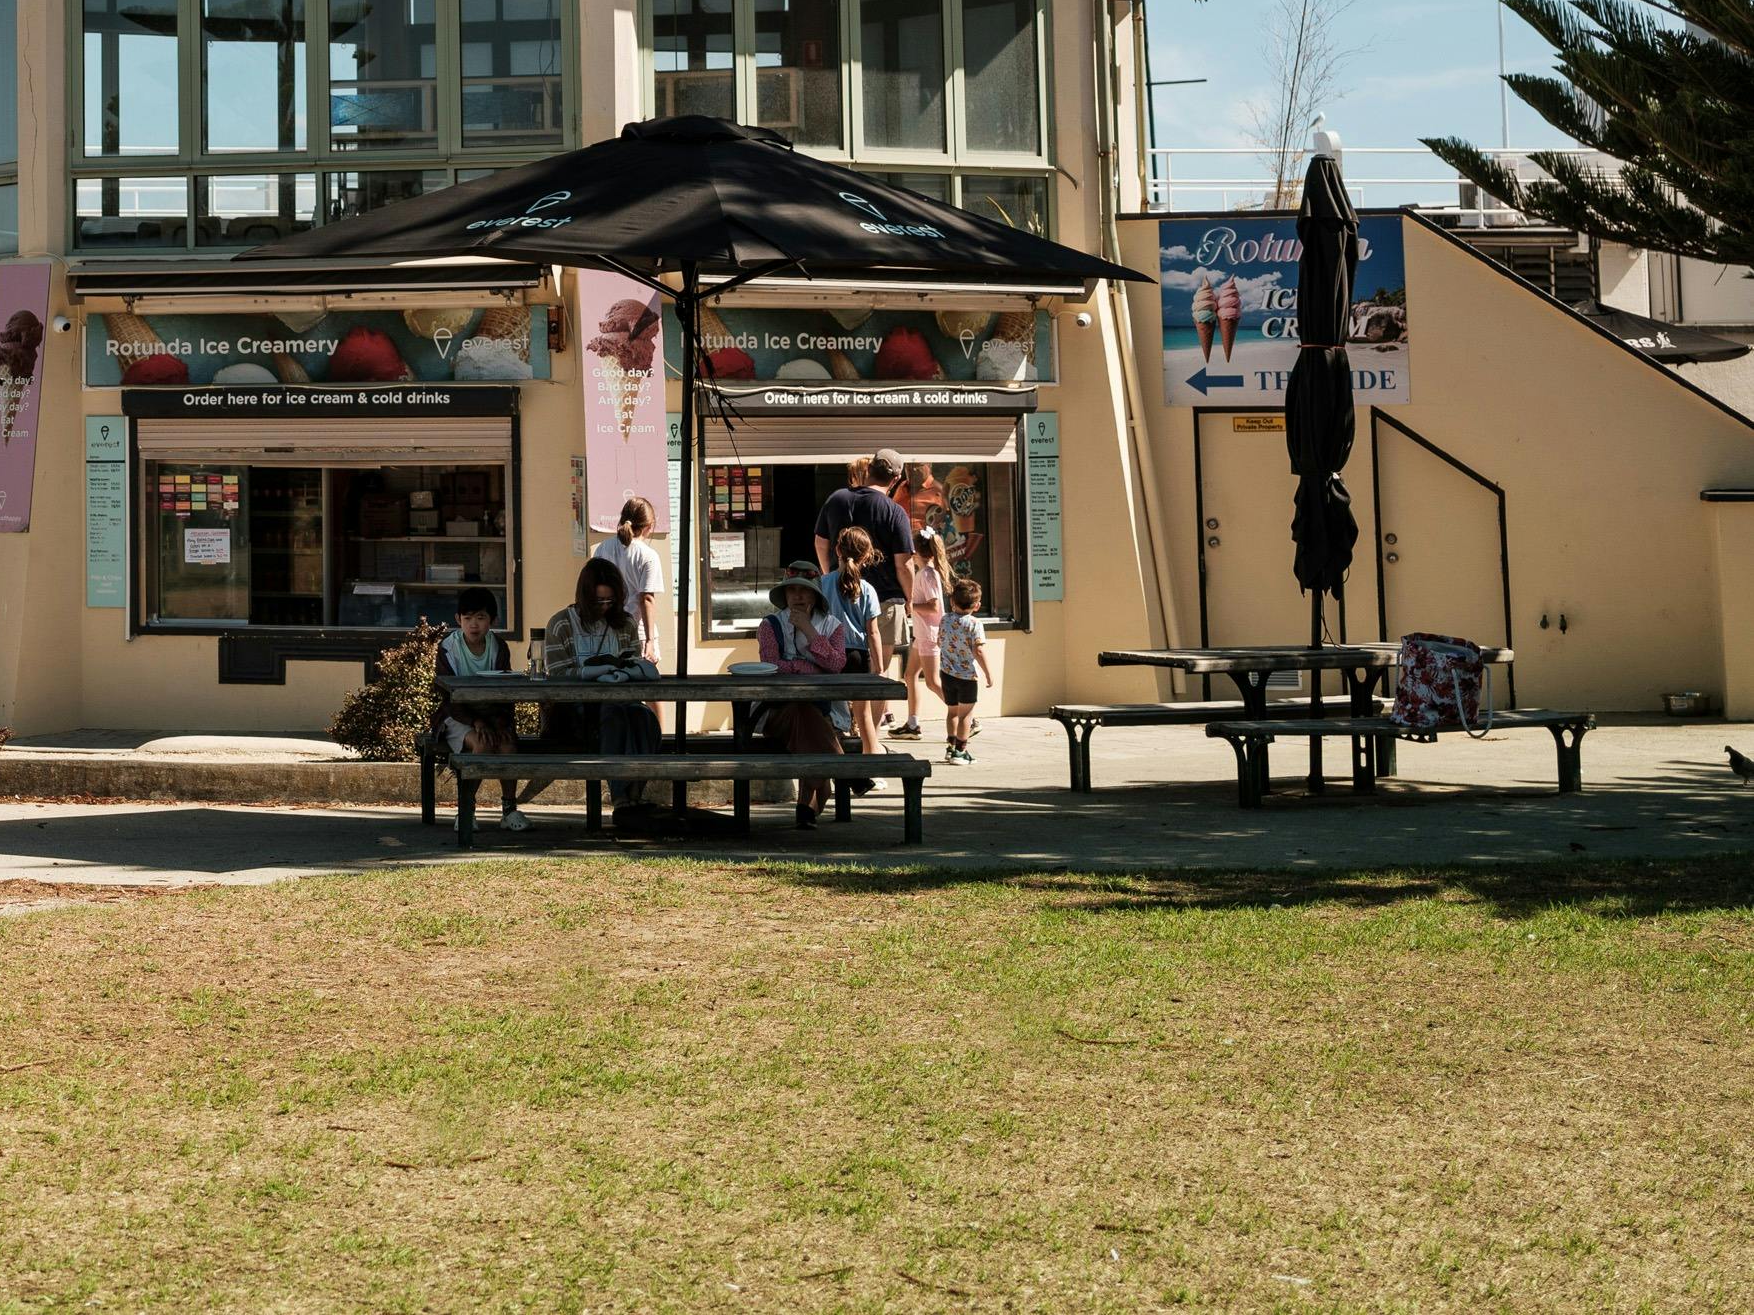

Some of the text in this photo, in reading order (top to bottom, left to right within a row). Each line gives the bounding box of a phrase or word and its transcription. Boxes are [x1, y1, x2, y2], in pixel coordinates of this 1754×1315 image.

[466, 216, 572, 230] everest
[859, 221, 946, 239] everest
[1196, 226, 1373, 266] Rotua
[1260, 287, 1298, 310] IC
[1261, 315, 1368, 339] CRM
[106, 336, 339, 356] Rotunda Ice Creamery
[461, 333, 530, 350] everest
[680, 332, 883, 353] otunda Ice Creamery
[982, 337, 1035, 352] everest
[592, 367, 655, 380] Good day?
[14, 376, 35, 386] day?
[1353, 370, 1397, 391] IDE
[597, 381, 651, 394] Bad day?
[10, 390, 31, 400] day?
[183, 391, 450, 406] Order here for ice cream & cold drinks
[598, 395, 652, 407] Any day?
[764, 392, 988, 405] Order here for ice cream & cold drinks
[9, 402, 30, 412] day?
[0, 416, 15, 424] Eat
[614, 410, 633, 420] Eat
[1, 429, 29, 438] Cream
[597, 423, 656, 434] Ice Cream
[950, 547, 967, 558] WAY
